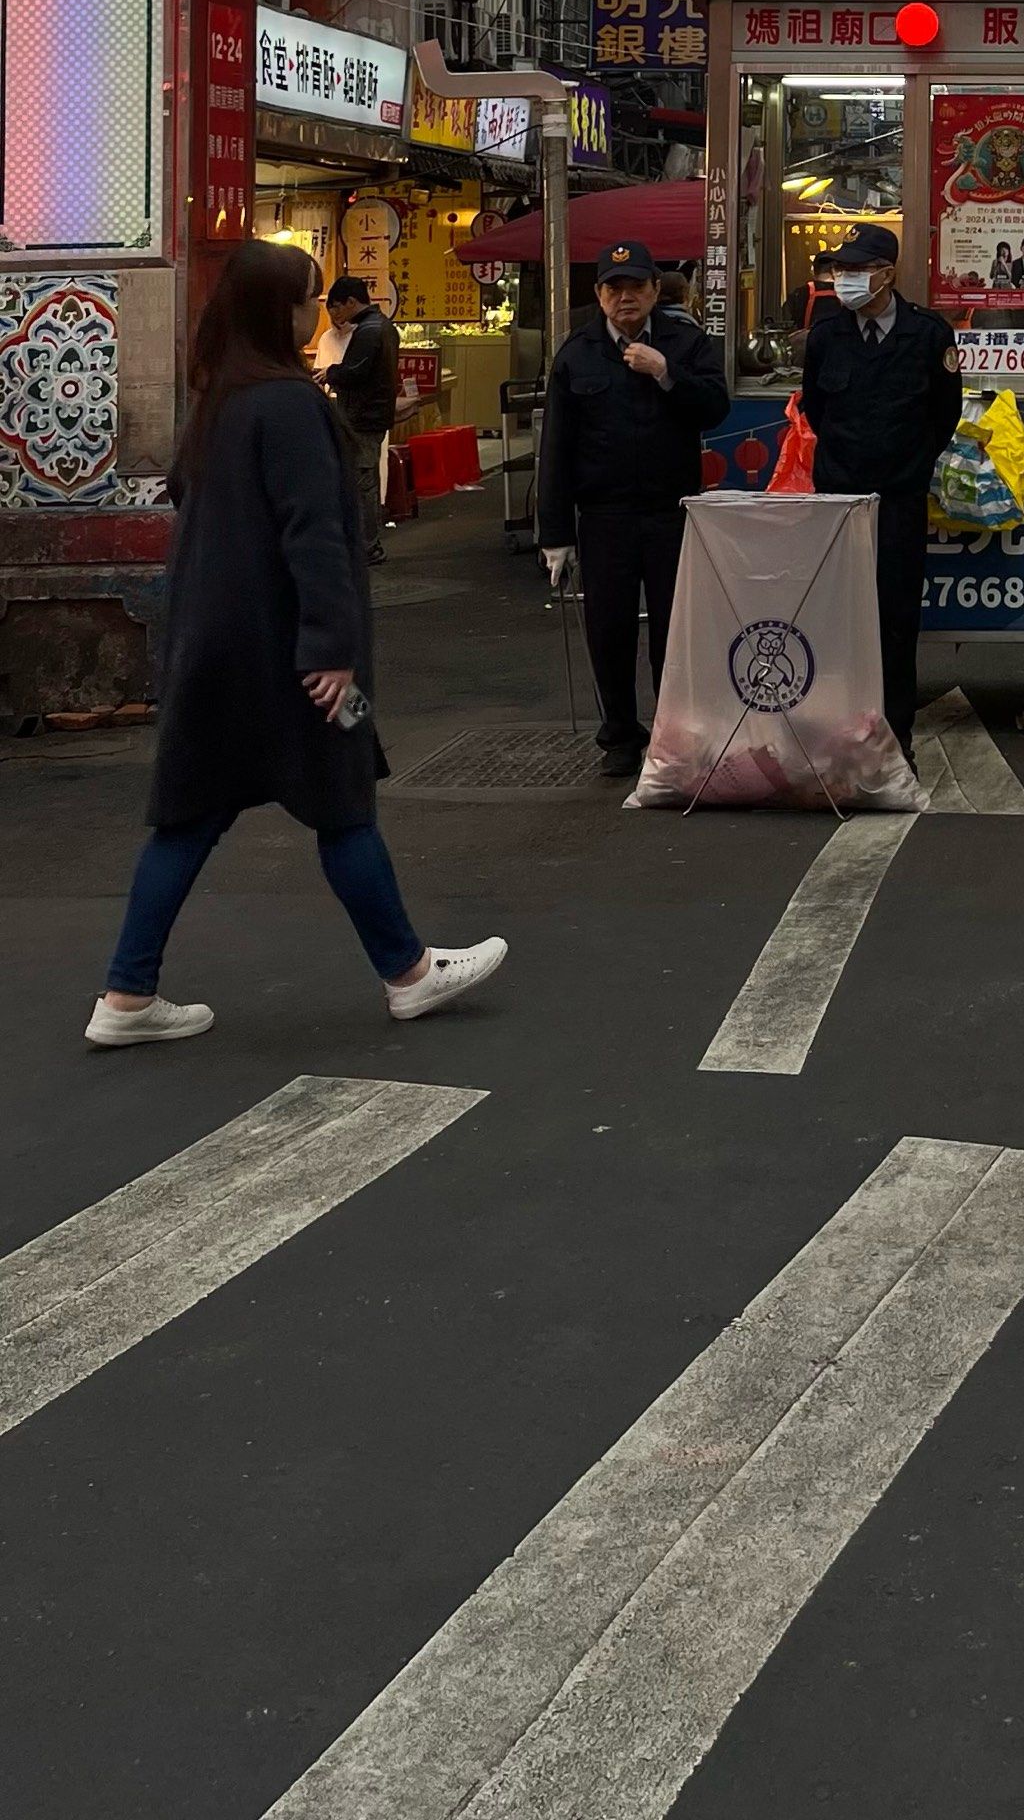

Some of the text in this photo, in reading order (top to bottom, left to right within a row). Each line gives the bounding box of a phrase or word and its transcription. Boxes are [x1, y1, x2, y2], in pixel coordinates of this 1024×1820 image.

[596, 24, 708, 66] 銀樓
[745, 7, 900, 47] 媽祖廟口
[296, 41, 336, 100] 排骨酥
[708, 167, 726, 240] 小心扒手
[705, 245, 727, 337] 請靠右走
